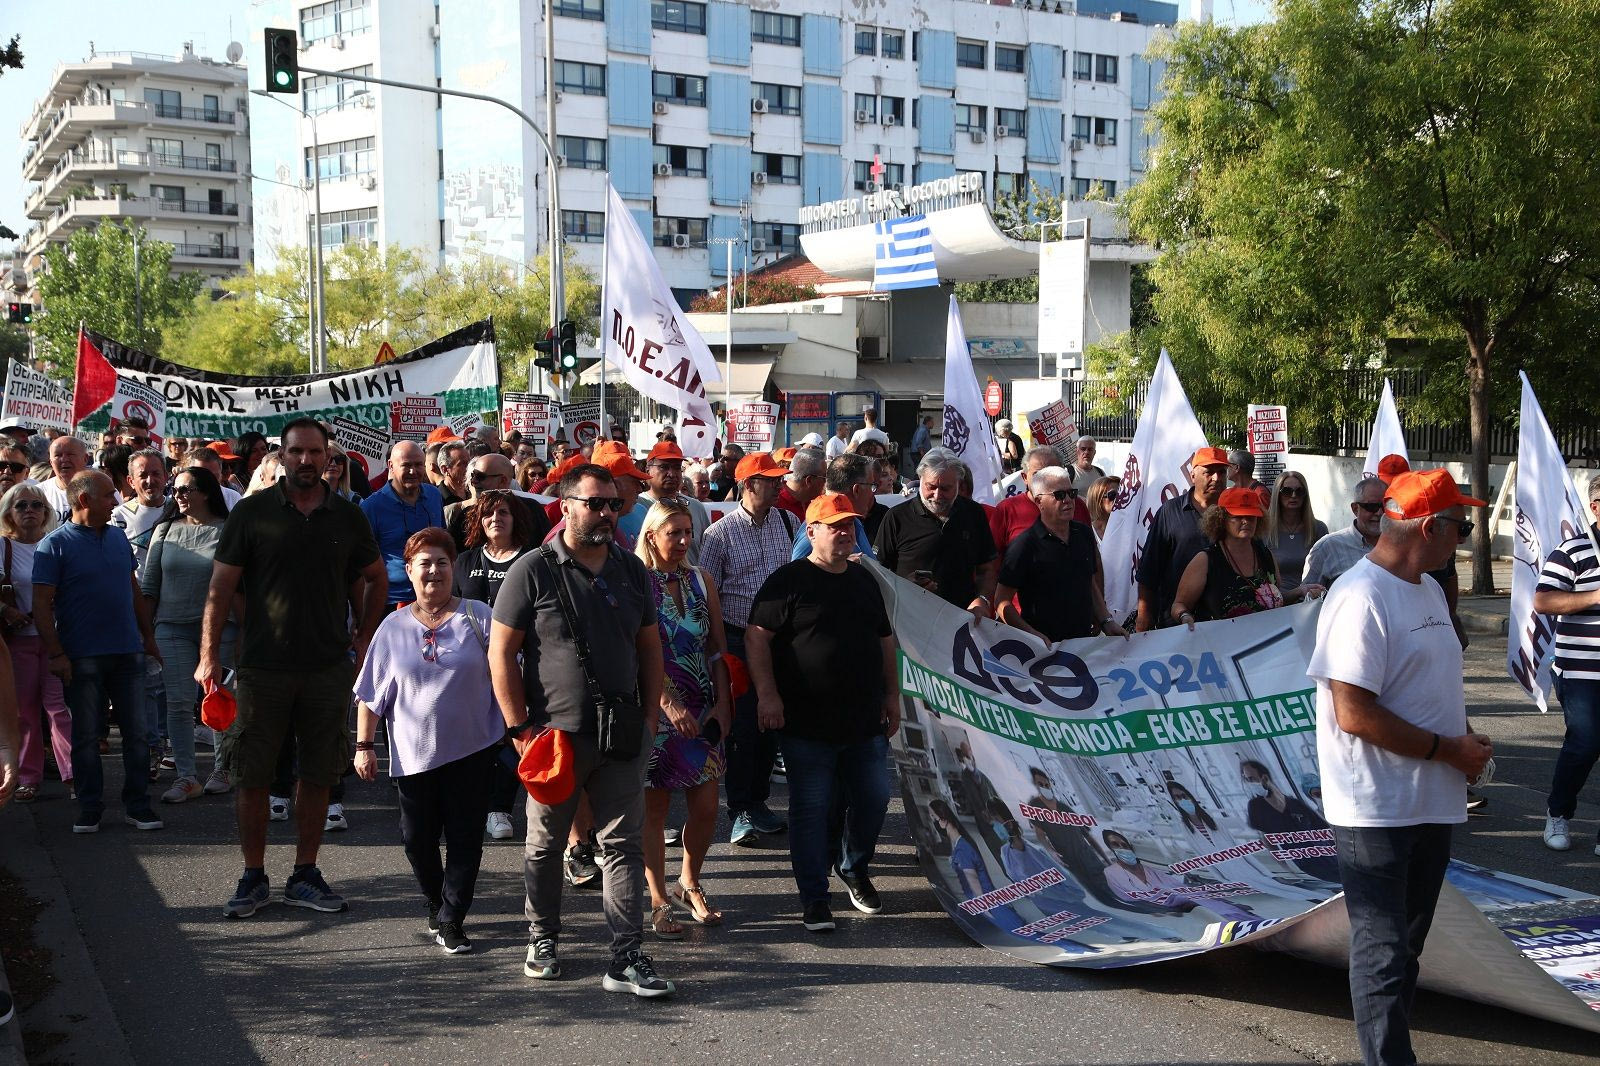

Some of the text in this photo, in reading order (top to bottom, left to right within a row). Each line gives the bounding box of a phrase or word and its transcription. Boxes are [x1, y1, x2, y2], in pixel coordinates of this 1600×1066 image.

[798, 199, 860, 225] ΙΠΠΟΚΡΑΤΕΙΟ
[903, 172, 983, 206] ΝΟΣΟΚΟΜΕΙΟ
[255, 384, 312, 400] ΜΕΧΡΙ
[329, 369, 404, 404] ΝΙΚΗ
[7, 399, 62, 421] ΜΕΤΑΤΡΟΠΗ
[270, 400, 299, 412] ΤΗ
[407, 399, 434, 407] ΜΑΖΙΚΕΣ
[744, 405, 770, 413] ΜΑΖΙΚΕΣ
[1256, 410, 1280, 419] ΜΑΖΙΚΕΣ
[334, 428, 383, 452] ΚΥΒΕΡΝΗΣΗ
[337, 439, 383, 460] ΟΛΟΦΟΝΩΝ
[1107, 651, 1229, 702] 2024
[969, 693, 1027, 742] ΥΓΕΙΑ
[1033, 717, 1137, 753] ΠΡΟΝΟΙΑ
[1147, 708, 1213, 746] ΕΚΑΒ
[1209, 705, 1246, 739] ΣΕ
[1019, 802, 1098, 828] ΕΡΓΟΛΑΒΟΙ
[1169, 839, 1267, 875] ΙΔΙΩΤΙΚΟΠΟΙΗΣΗ
[1271, 847, 1336, 861] ΕΞΟΥΘΕΝ
[959, 867, 1066, 915] ΥΠΟΧΡΗΜΑΤΟΔΟΤΗΣΗ
